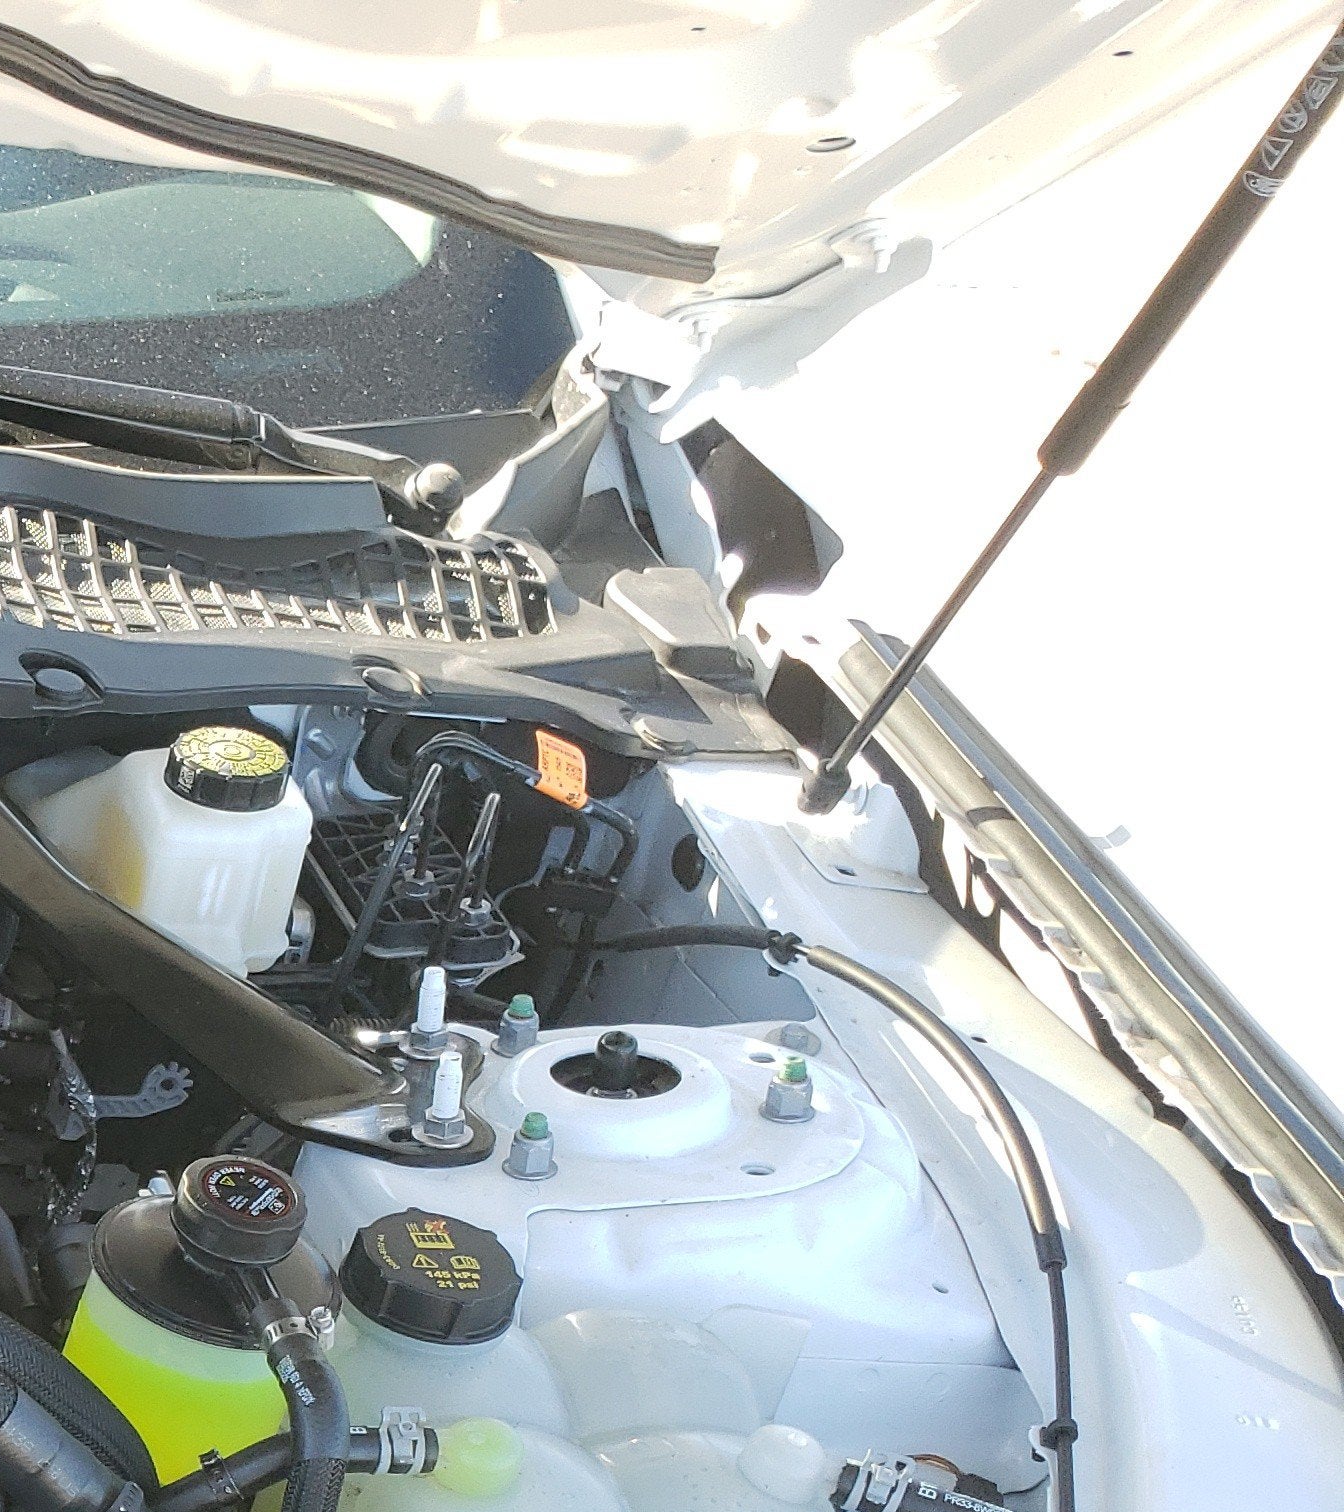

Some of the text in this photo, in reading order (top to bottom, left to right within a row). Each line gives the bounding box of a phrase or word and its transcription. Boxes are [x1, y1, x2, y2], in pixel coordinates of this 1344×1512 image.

[425, 1270, 481, 1280] 145 kPa
[437, 1280, 479, 1290] 21 psi
